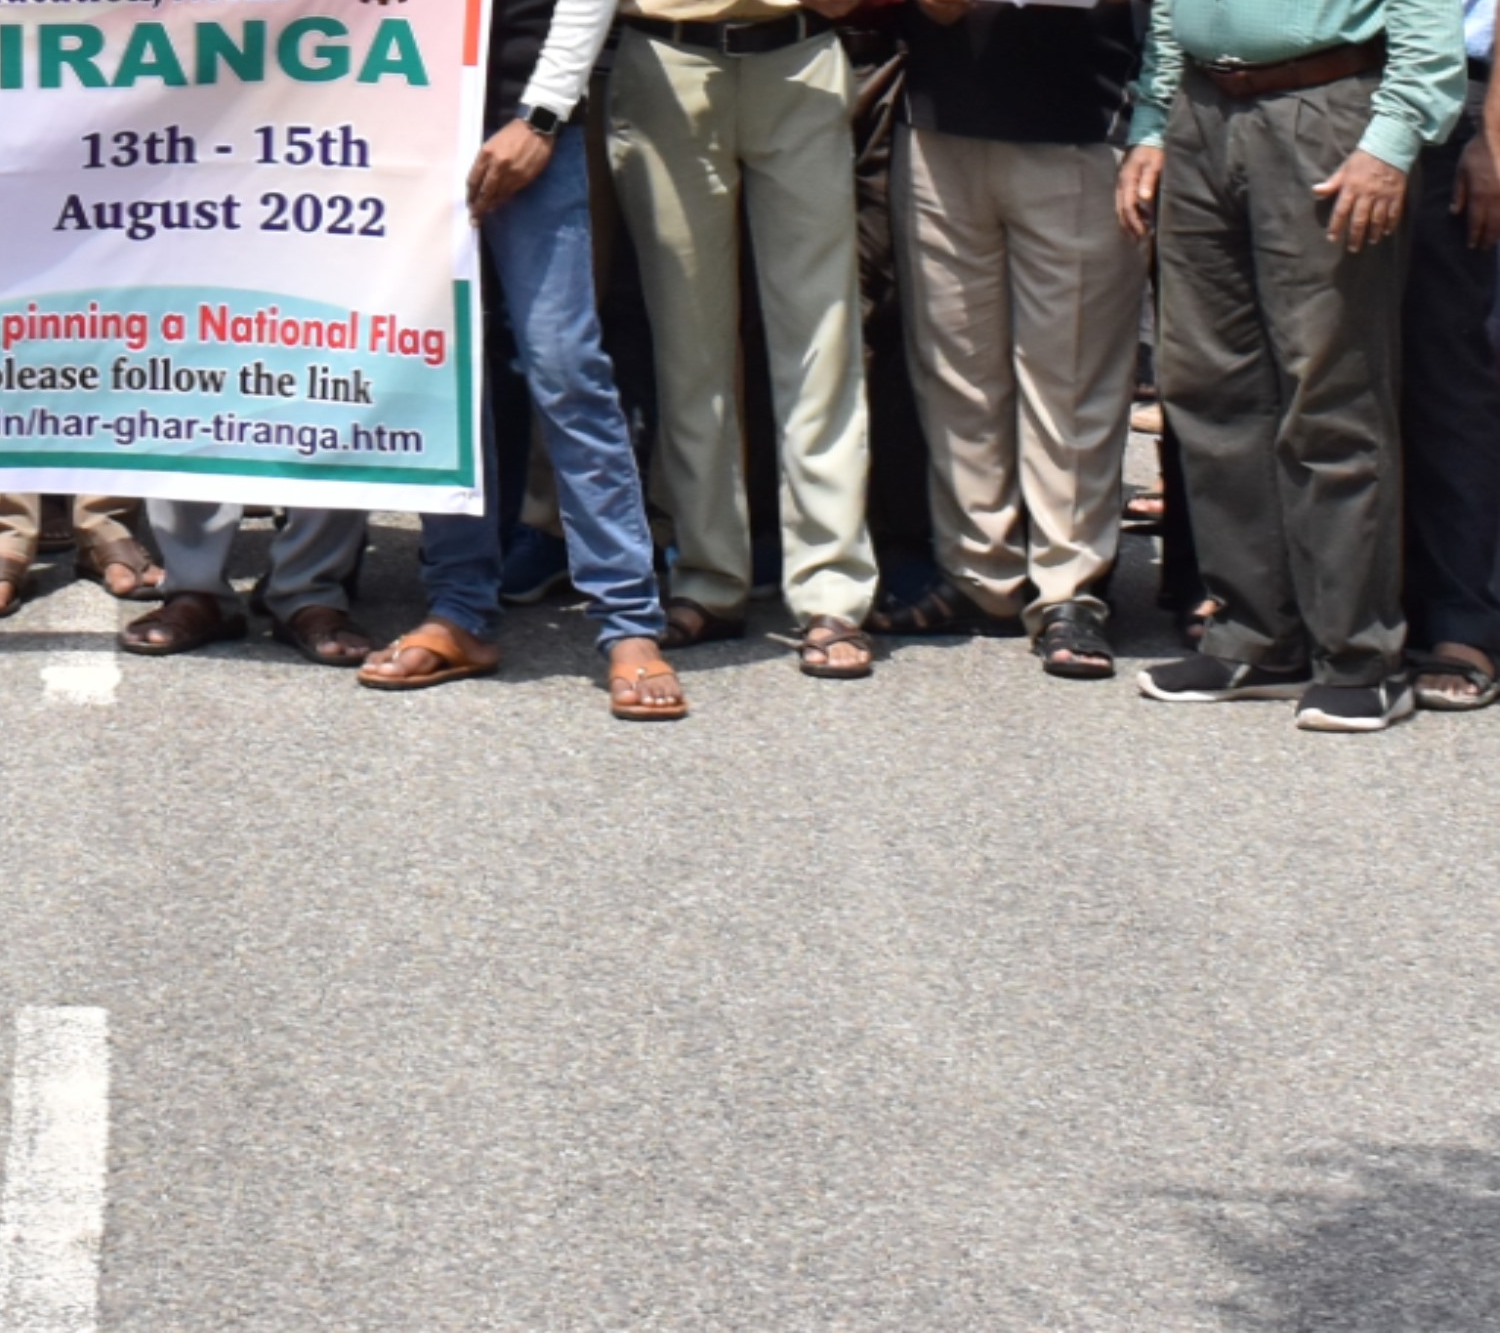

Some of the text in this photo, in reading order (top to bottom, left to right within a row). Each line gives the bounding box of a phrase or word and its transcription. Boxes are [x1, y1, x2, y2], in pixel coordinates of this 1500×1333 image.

[81, 123, 198, 169] 13th
[251, 124, 371, 169] 15th
[53, 192, 387, 241] August 2022
[1, 303, 149, 351] pinning
[159, 314, 186, 342] a
[197, 304, 360, 353] National
[367, 314, 446, 366] Flag
[110, 356, 227, 394] follow
[238, 358, 297, 399] the
[305, 363, 373, 405] link
